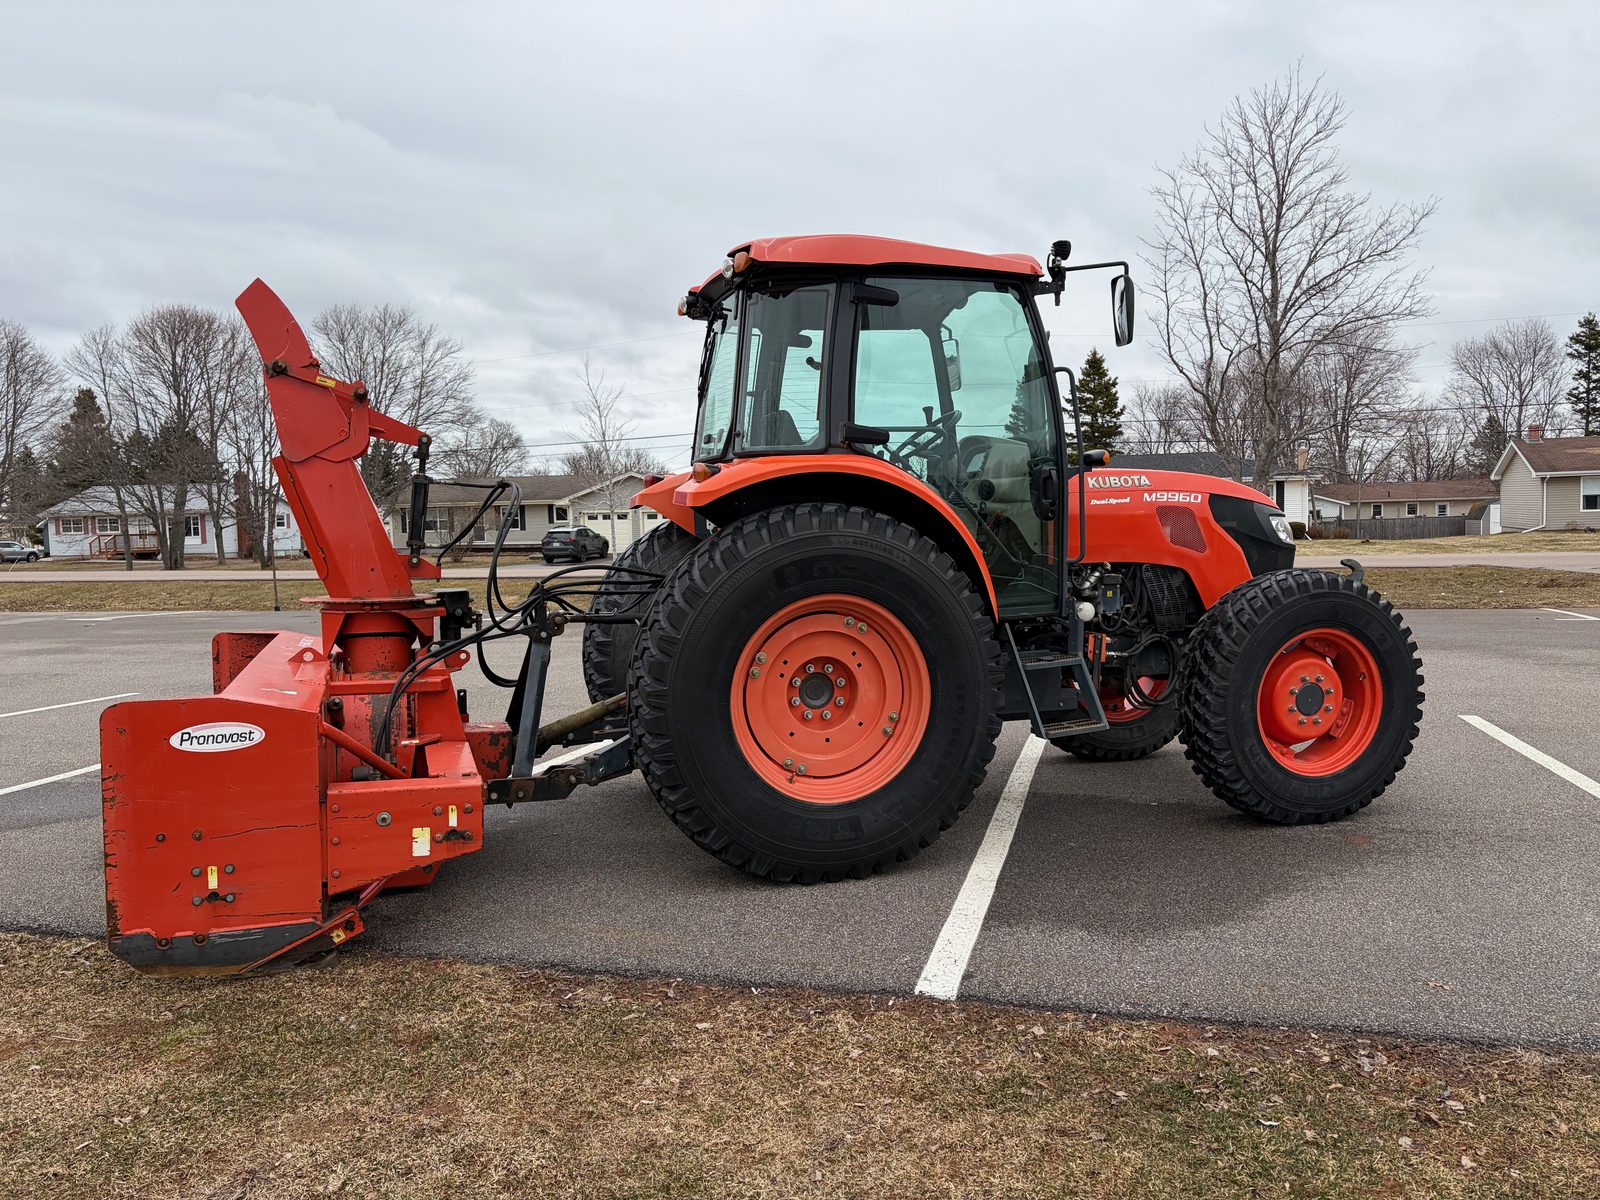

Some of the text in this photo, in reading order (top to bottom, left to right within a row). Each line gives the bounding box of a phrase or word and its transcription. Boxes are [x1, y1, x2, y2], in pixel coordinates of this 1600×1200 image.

[1087, 475, 1151, 489] KUBOTA
[1143, 492, 1202, 503] M9960
[179, 729, 255, 747] Pronovost
